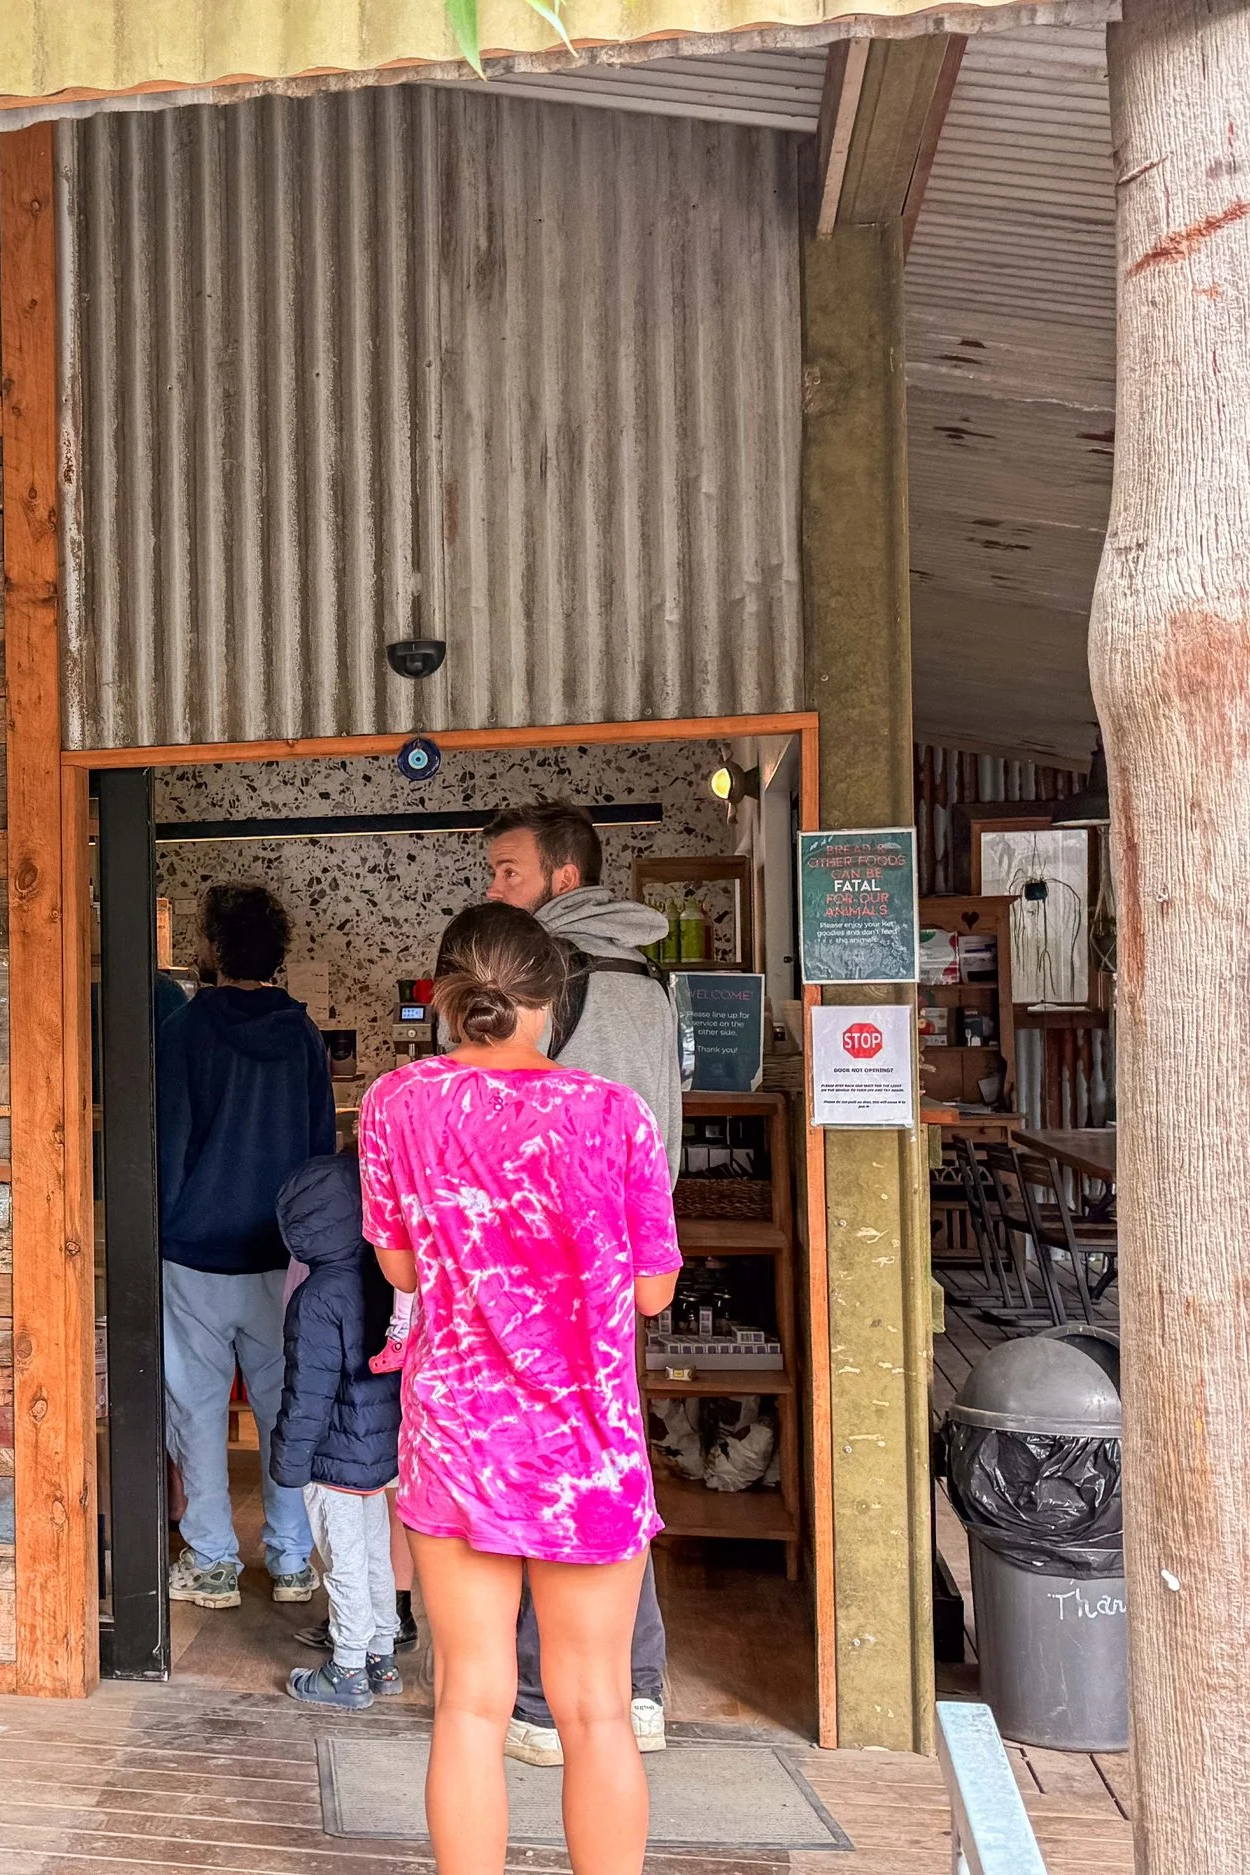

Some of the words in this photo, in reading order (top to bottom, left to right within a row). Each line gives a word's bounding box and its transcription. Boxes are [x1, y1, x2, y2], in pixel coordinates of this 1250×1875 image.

[826, 844, 871, 855] BREAD
[807, 856, 853, 868] OTHER
[858, 855, 906, 867] FOODS
[830, 869, 861, 879] CAN
[866, 867, 883, 879] BE
[834, 879, 881, 892] FATAL
[826, 893, 853, 905] FOR
[859, 892, 889, 904] OUR
[825, 905, 888, 917] ANIMALS
[819, 921, 843, 929] Please
[844, 921, 863, 931] enjoy
[864, 921, 880, 929] your
[816, 930, 845, 938] goodies
[686, 1010, 710, 1018] Please
[712, 1010, 726, 1018] line
[727, 1012, 738, 1020] up
[844, 1032, 882, 1049] STOP
